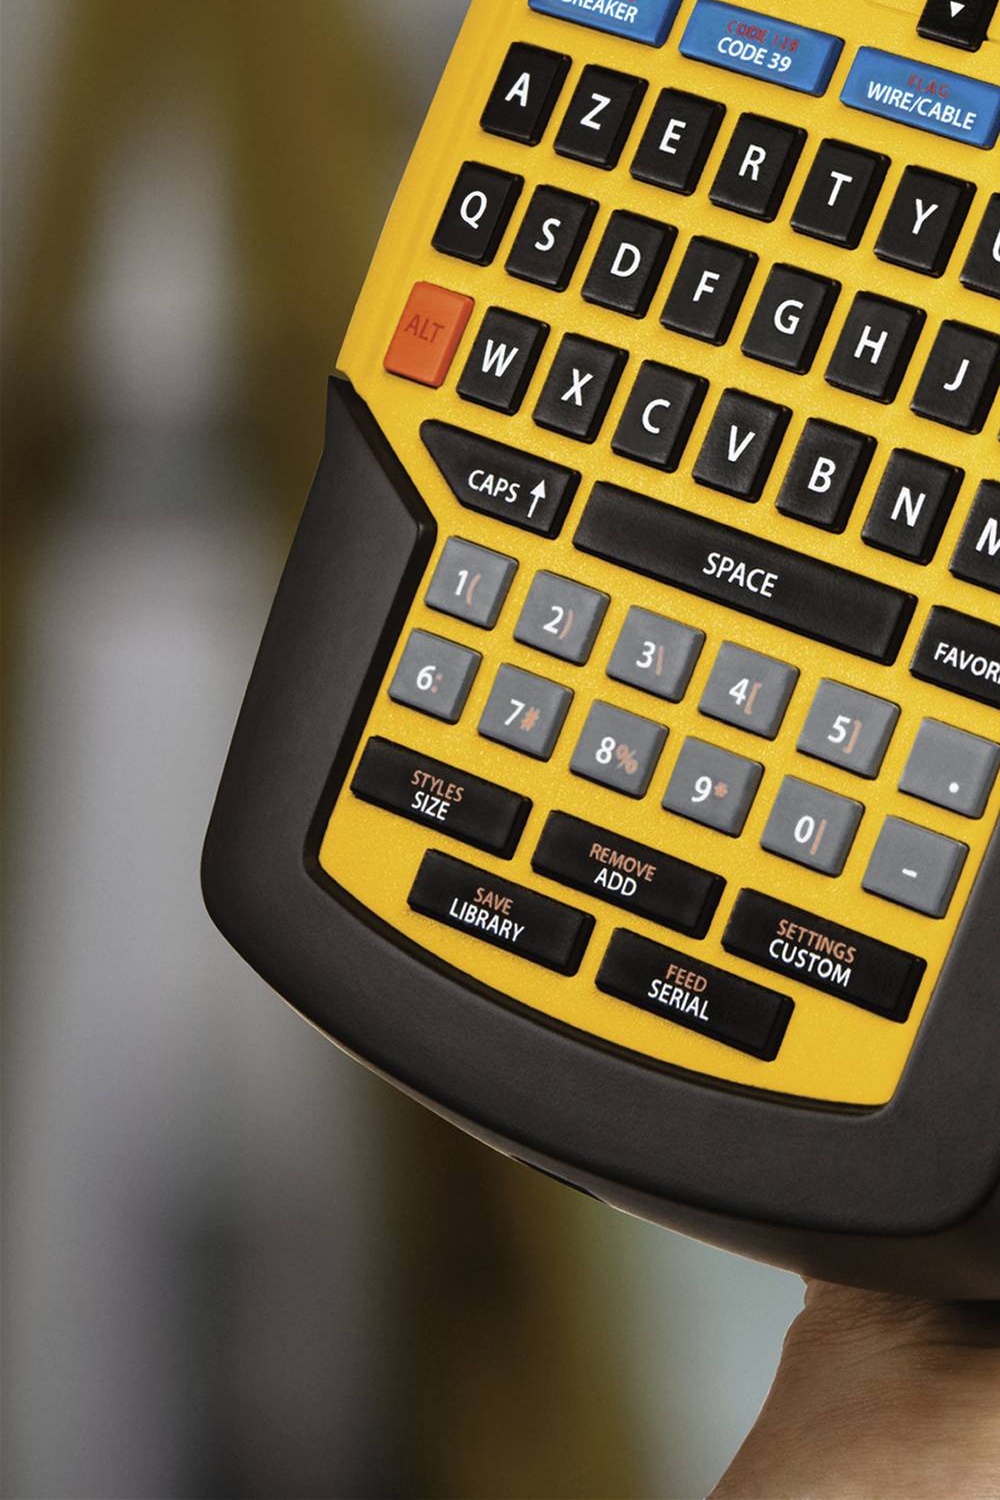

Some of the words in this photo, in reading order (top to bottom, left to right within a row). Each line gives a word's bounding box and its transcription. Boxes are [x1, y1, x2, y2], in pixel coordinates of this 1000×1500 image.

[727, 20, 769, 44] CODE
[717, 36, 768, 66] CODE
[768, 48, 792, 73] 39
[505, 72, 531, 107] A
[907, 73, 949, 99] FLAG
[580, 93, 611, 130] Z
[866, 81, 977, 131] WIRE/CABLE
[659, 118, 686, 154] E
[739, 144, 767, 181] R
[828, 171, 853, 207] T
[459, 190, 487, 229] Q
[911, 198, 939, 235] Y
[534, 218, 561, 252] S
[610, 242, 642, 278] D
[692, 270, 720, 302] F
[404, 314, 445, 345] ALT
[772, 299, 804, 335] G
[481, 339, 519, 379] W
[854, 325, 889, 365] H
[561, 368, 594, 407] X
[943, 359, 970, 393] J
[642, 398, 671, 434] C
[726, 425, 756, 463] V
[467, 469, 521, 503] CAPS
[807, 457, 836, 494] B
[891, 487, 926, 528] N
[703, 552, 778, 598] SPACE
[411, 770, 463, 802] STYLES
[412, 791, 450, 821] SIZE
[590, 842, 656, 883] REMOVE
[594, 867, 637, 897] ADD
[473, 887, 513, 916] SAVE
[449, 899, 525, 943] LIBRARY
[776, 919, 857, 964] SETTINGS
[665, 963, 708, 994] FEED
[769, 939, 851, 988] CUSTOM
[648, 979, 709, 1022] SERIAL
